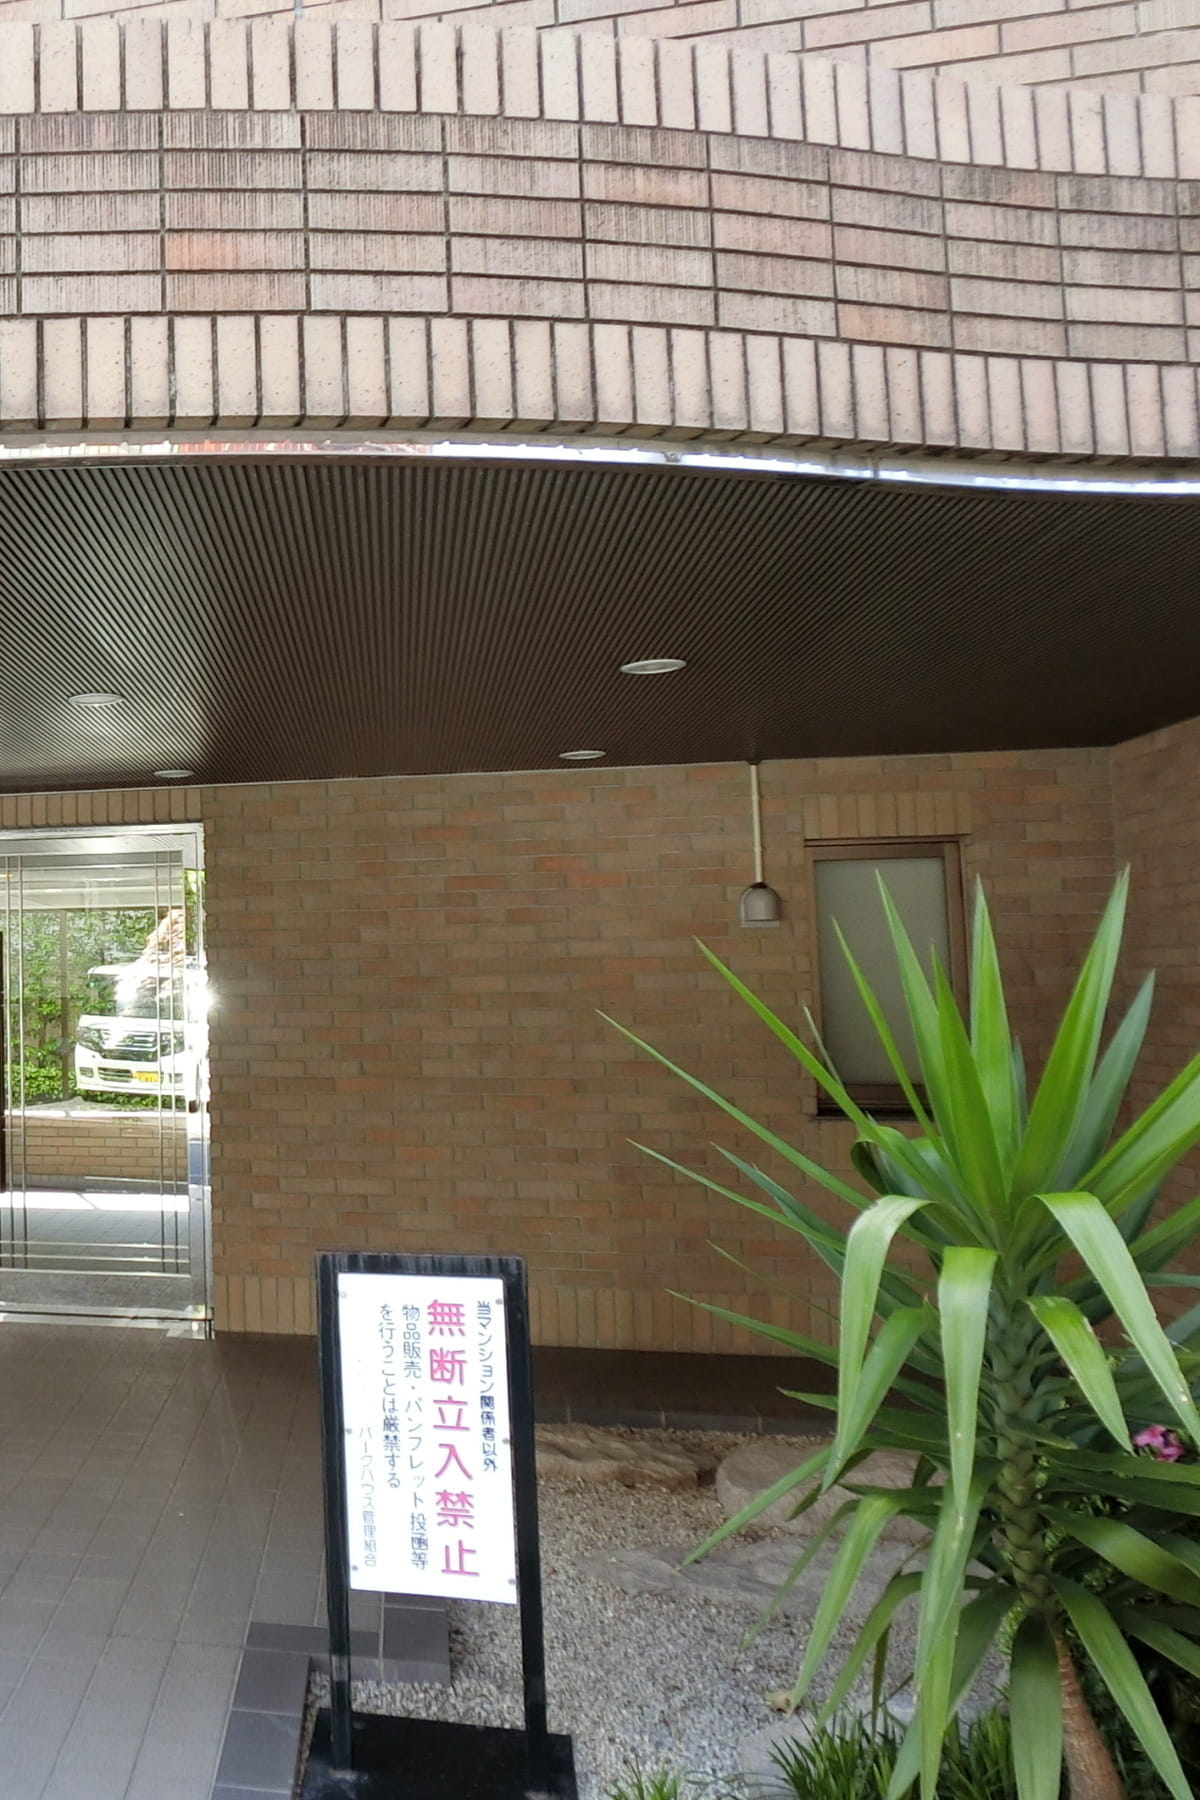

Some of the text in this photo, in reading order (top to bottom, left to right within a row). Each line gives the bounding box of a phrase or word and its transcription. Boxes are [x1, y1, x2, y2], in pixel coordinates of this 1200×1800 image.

[378, 1304, 401, 1488] を行うことは厳禁する
[427, 1299, 480, 1576] 無断立入禁止
[477, 1300, 497, 1472] 当マンション関係者以外
